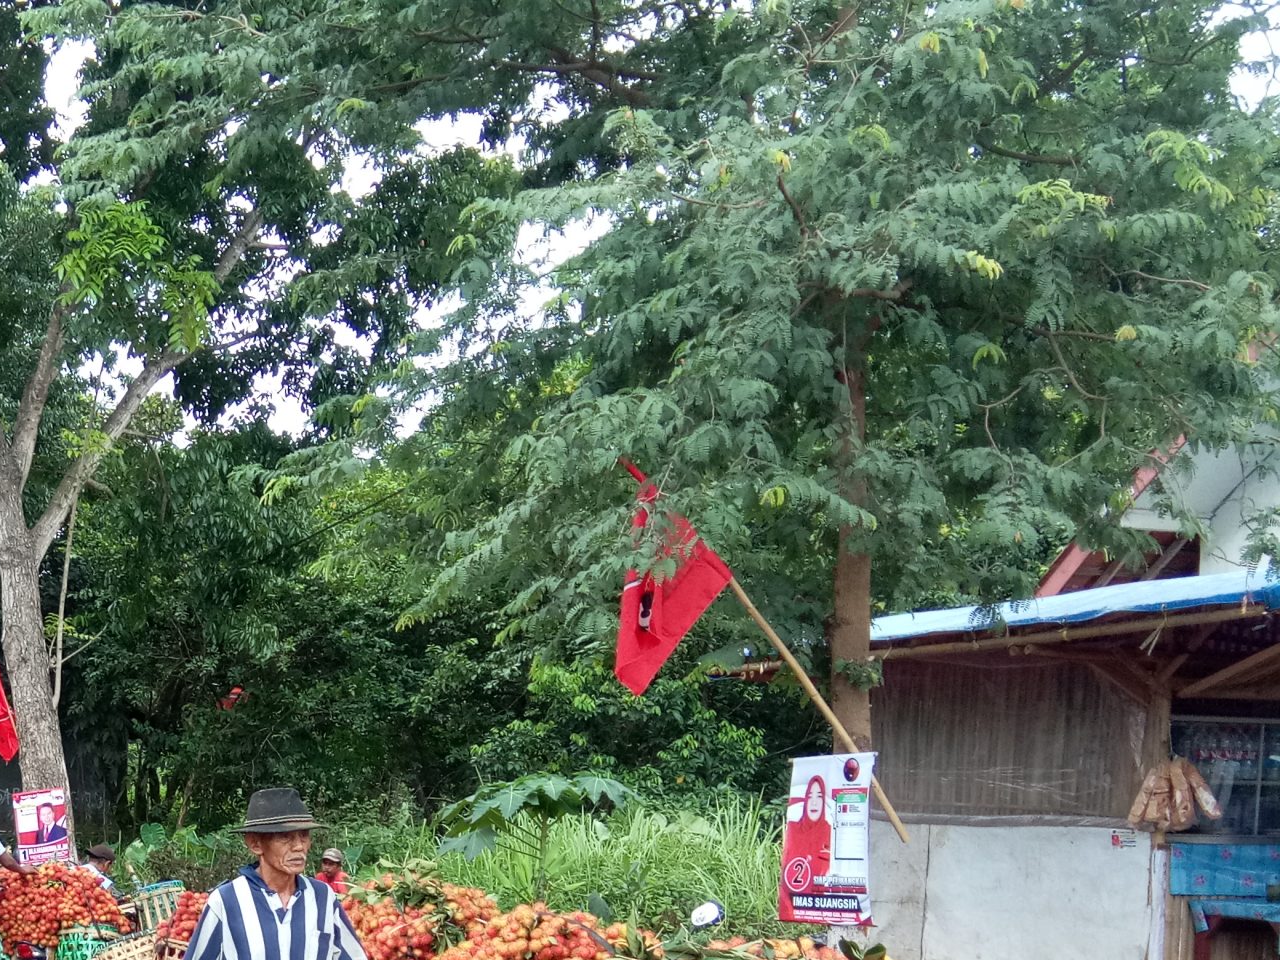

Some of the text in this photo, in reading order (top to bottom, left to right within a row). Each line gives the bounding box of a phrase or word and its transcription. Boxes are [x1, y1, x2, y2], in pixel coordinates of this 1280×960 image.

[22, 850, 27, 860] 1
[792, 862, 804, 884] 2
[792, 896, 858, 910] IMAS SUANGSIH
